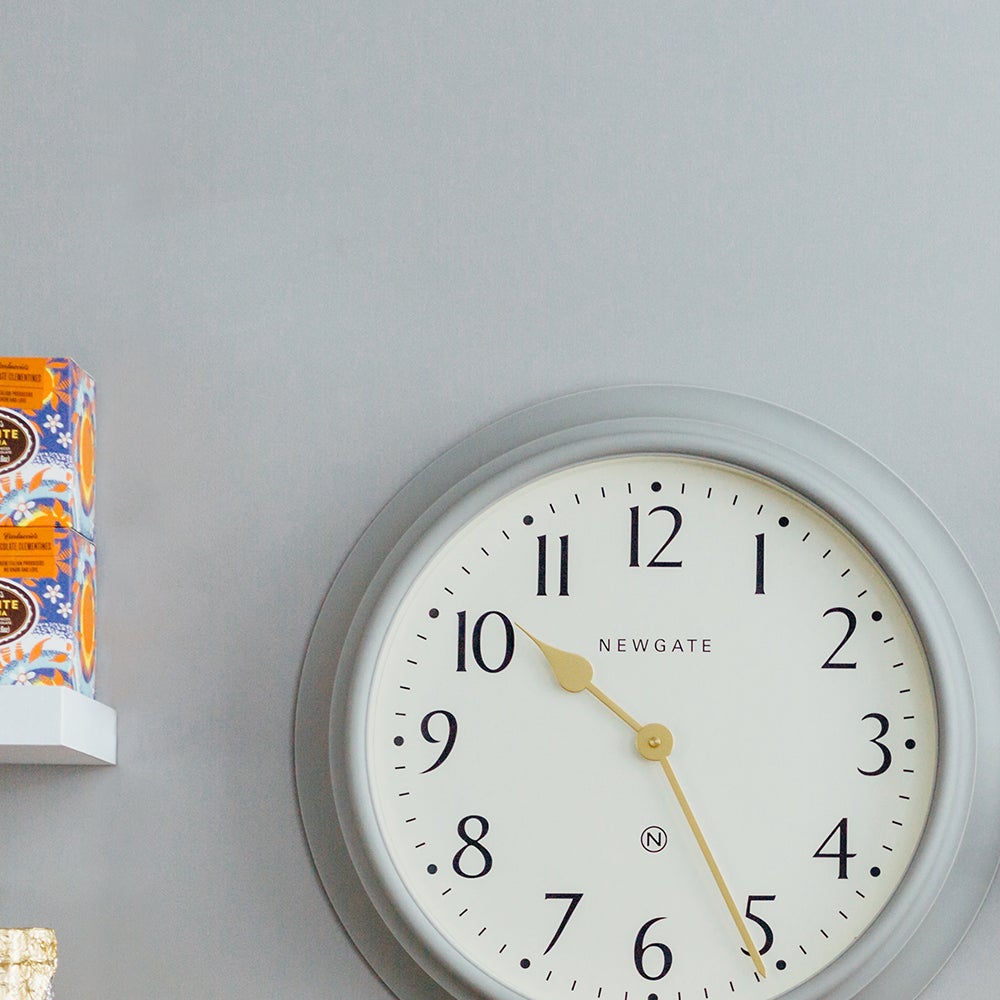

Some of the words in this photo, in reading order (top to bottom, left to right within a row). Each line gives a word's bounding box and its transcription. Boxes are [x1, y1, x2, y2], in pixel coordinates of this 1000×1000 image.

[536, 534, 570, 596] 11
[629, 505, 683, 568] 12
[754, 533, 765, 595] 1
[455, 610, 515, 673] 10
[599, 638, 713, 653] NEWGATE
[821, 606, 858, 669] 2
[419, 709, 458, 774] 9
[857, 713, 892, 776] 3
[452, 815, 493, 878] 8
[812, 817, 857, 879] 4
[543, 893, 584, 955] 7
[633, 916, 673, 980] 6
[740, 895, 776, 957] 5
